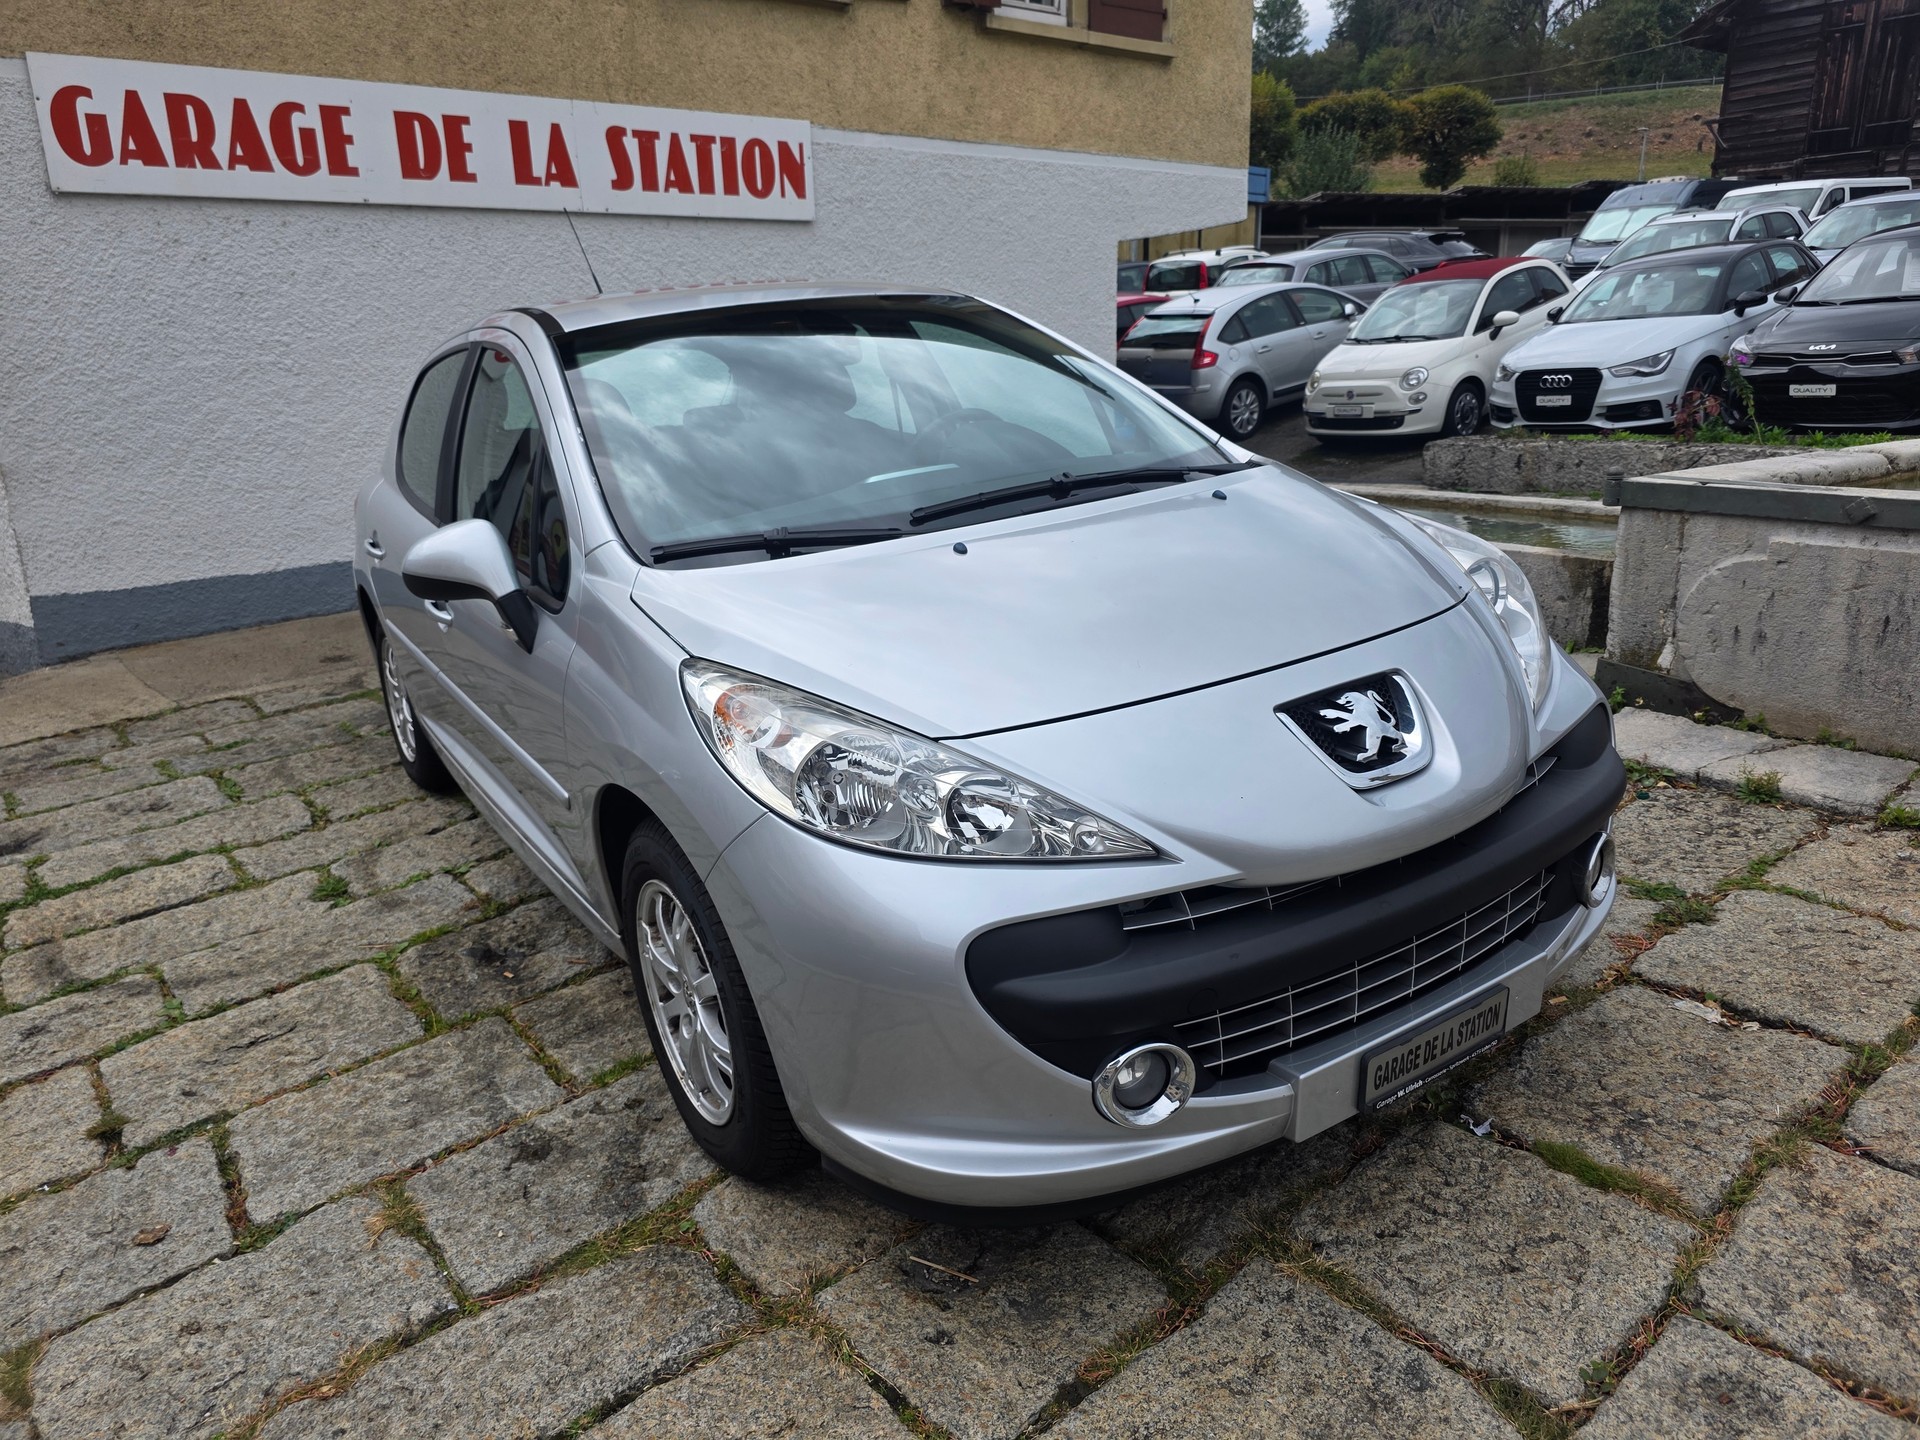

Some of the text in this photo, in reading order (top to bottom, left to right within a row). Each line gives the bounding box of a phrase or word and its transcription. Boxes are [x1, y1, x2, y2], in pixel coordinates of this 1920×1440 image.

[50, 85, 805, 199] GARAGE DE LA STATION
[1374, 1002, 1501, 1091] GARAGE DE LA STATION
[1376, 1094, 1397, 1109] Garage
[1405, 1079, 1423, 1093] Ulrich
